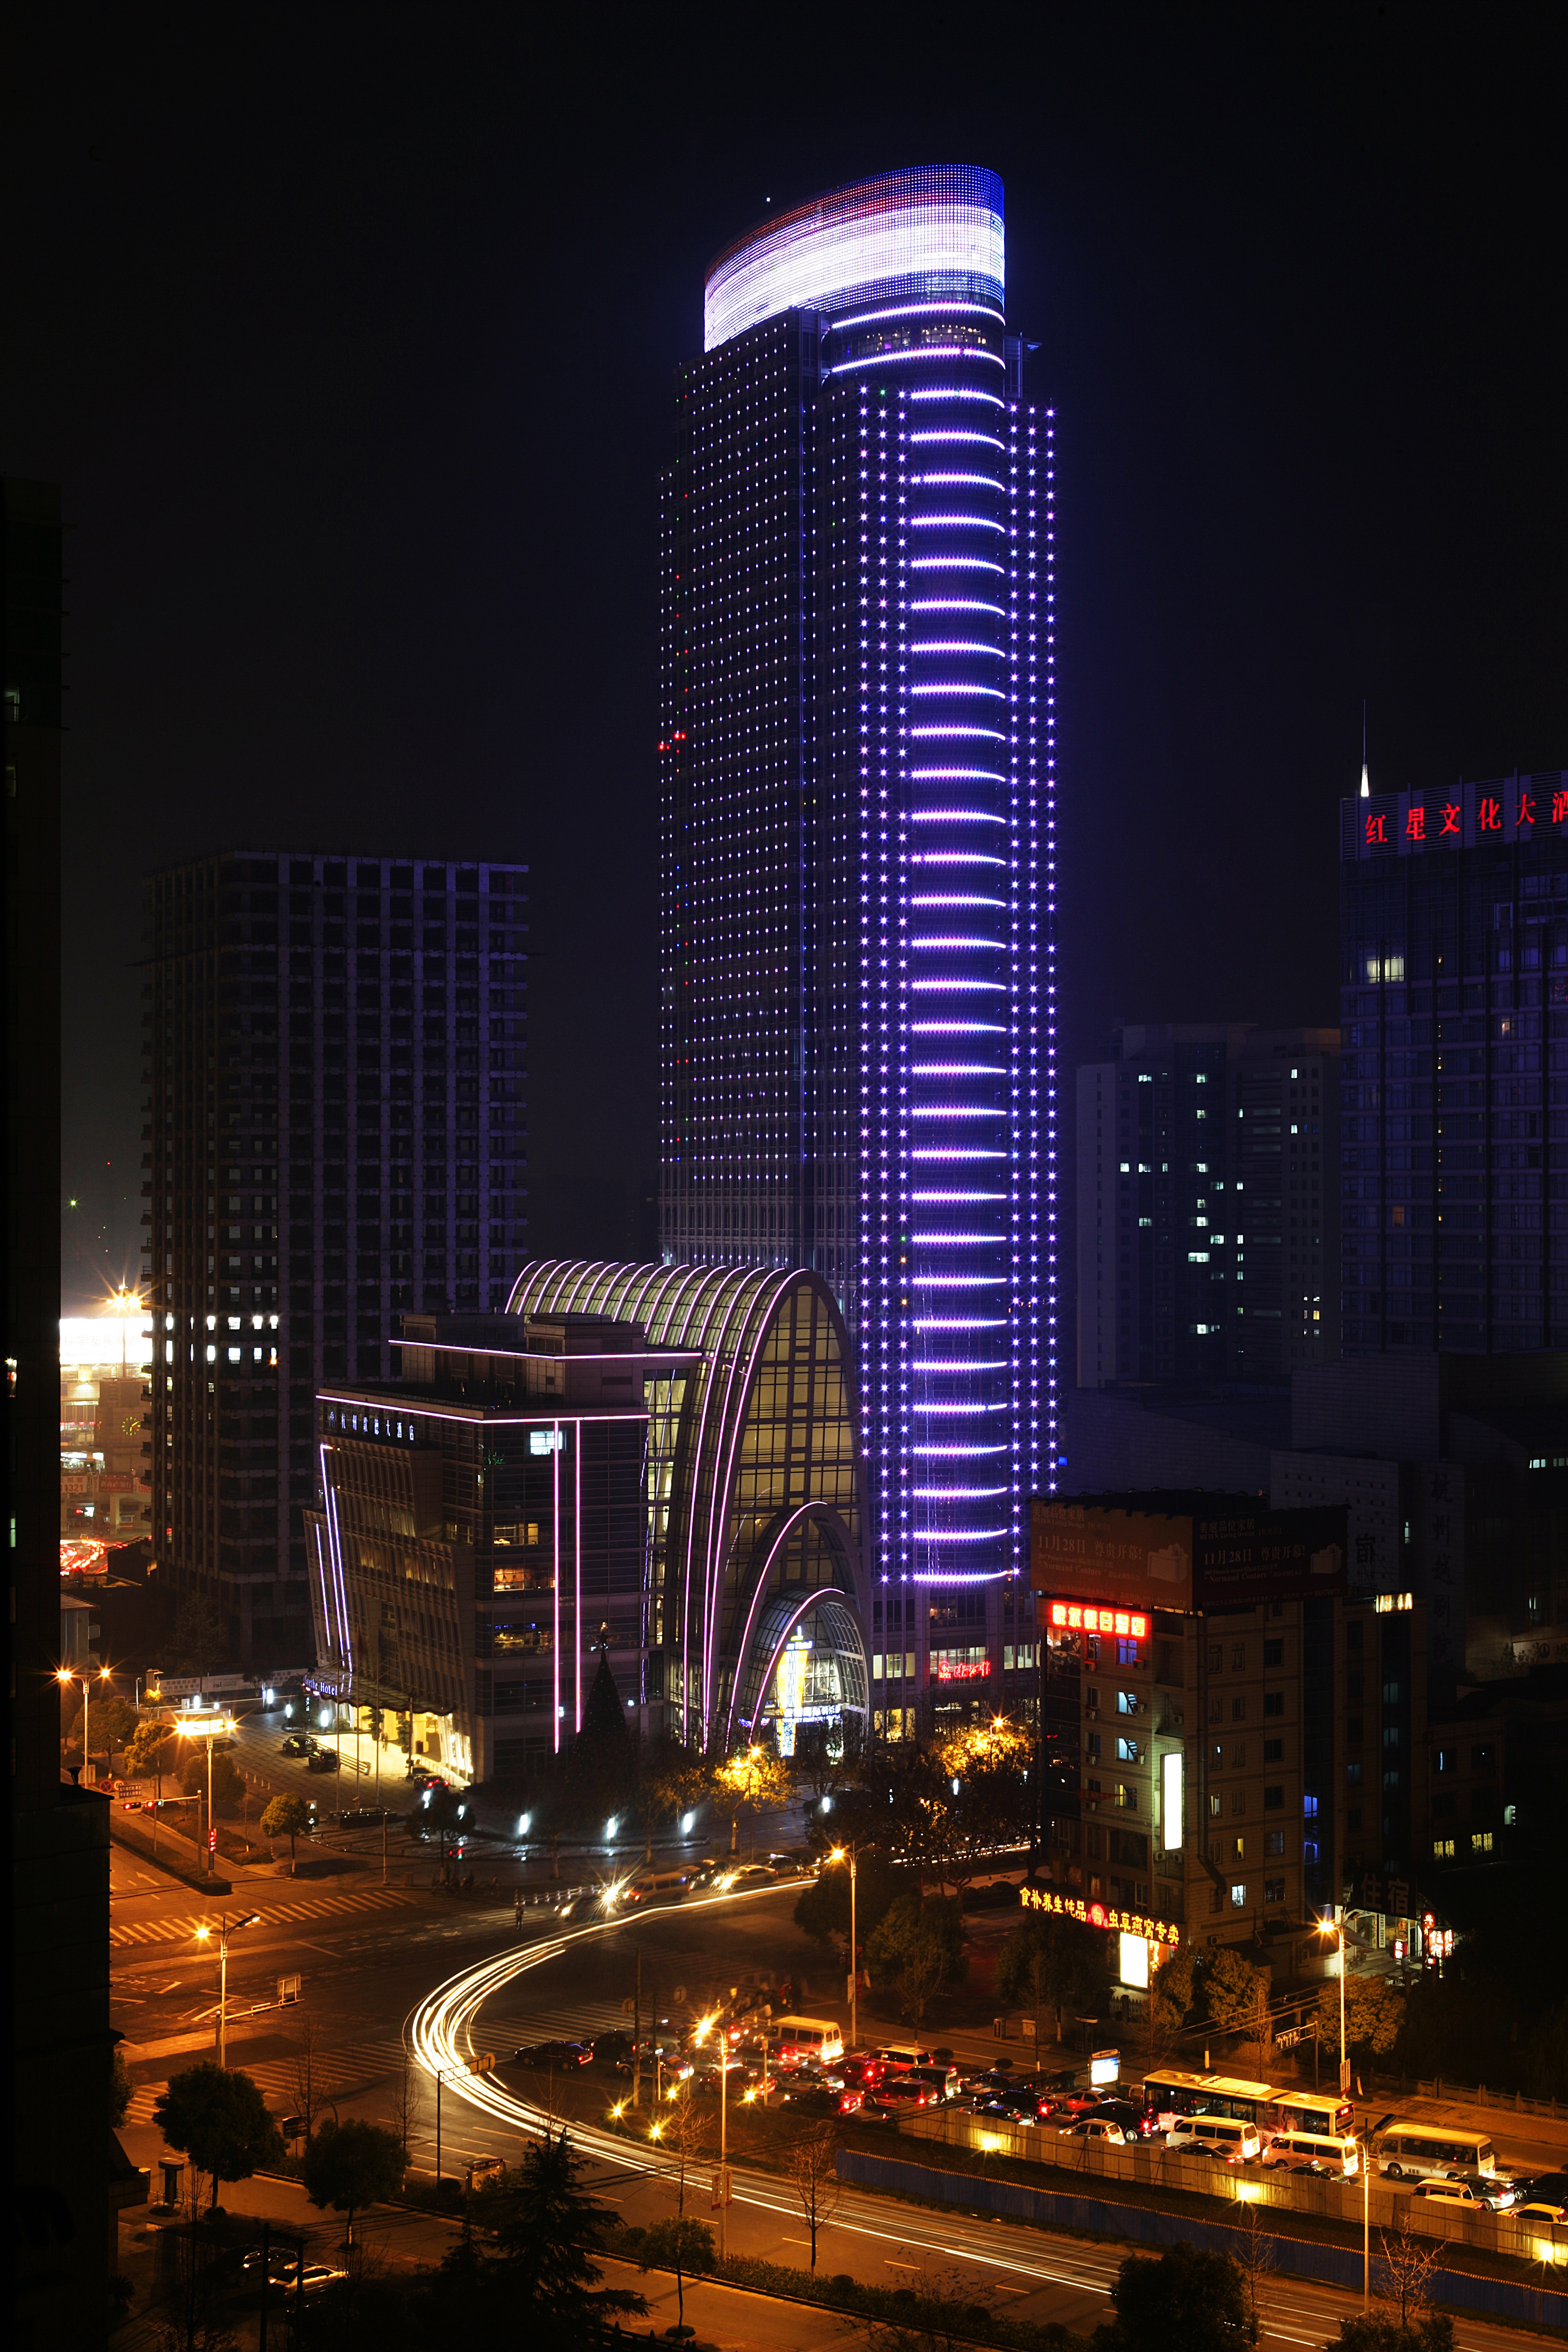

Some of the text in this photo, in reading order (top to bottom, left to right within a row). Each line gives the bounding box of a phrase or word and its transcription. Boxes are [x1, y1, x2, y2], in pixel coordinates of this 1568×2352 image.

[341, 1413, 414, 1441] 杭州歌德大酒店
[1033, 1506, 1084, 1521] 美庭品位家居
[1200, 1519, 1255, 1534] 美庭品位家居
[1038, 1535, 1142, 1560] 11月28日 尊贵开幕!
[1204, 1544, 1305, 1565] 11月28日 尊贵开幕!
[1242, 1572, 1267, 1581] Couture
[320, 1682, 337, 1696] Hotel
[1361, 1872, 1409, 1916] 住宿
[1020, 1887, 1086, 1922] 食补养生炖品
[1108, 1910, 1179, 1945] 虫草燕窝专卖
[1395, 1941, 1403, 1960] 住宿
[1429, 1930, 1444, 1958] 住宿
